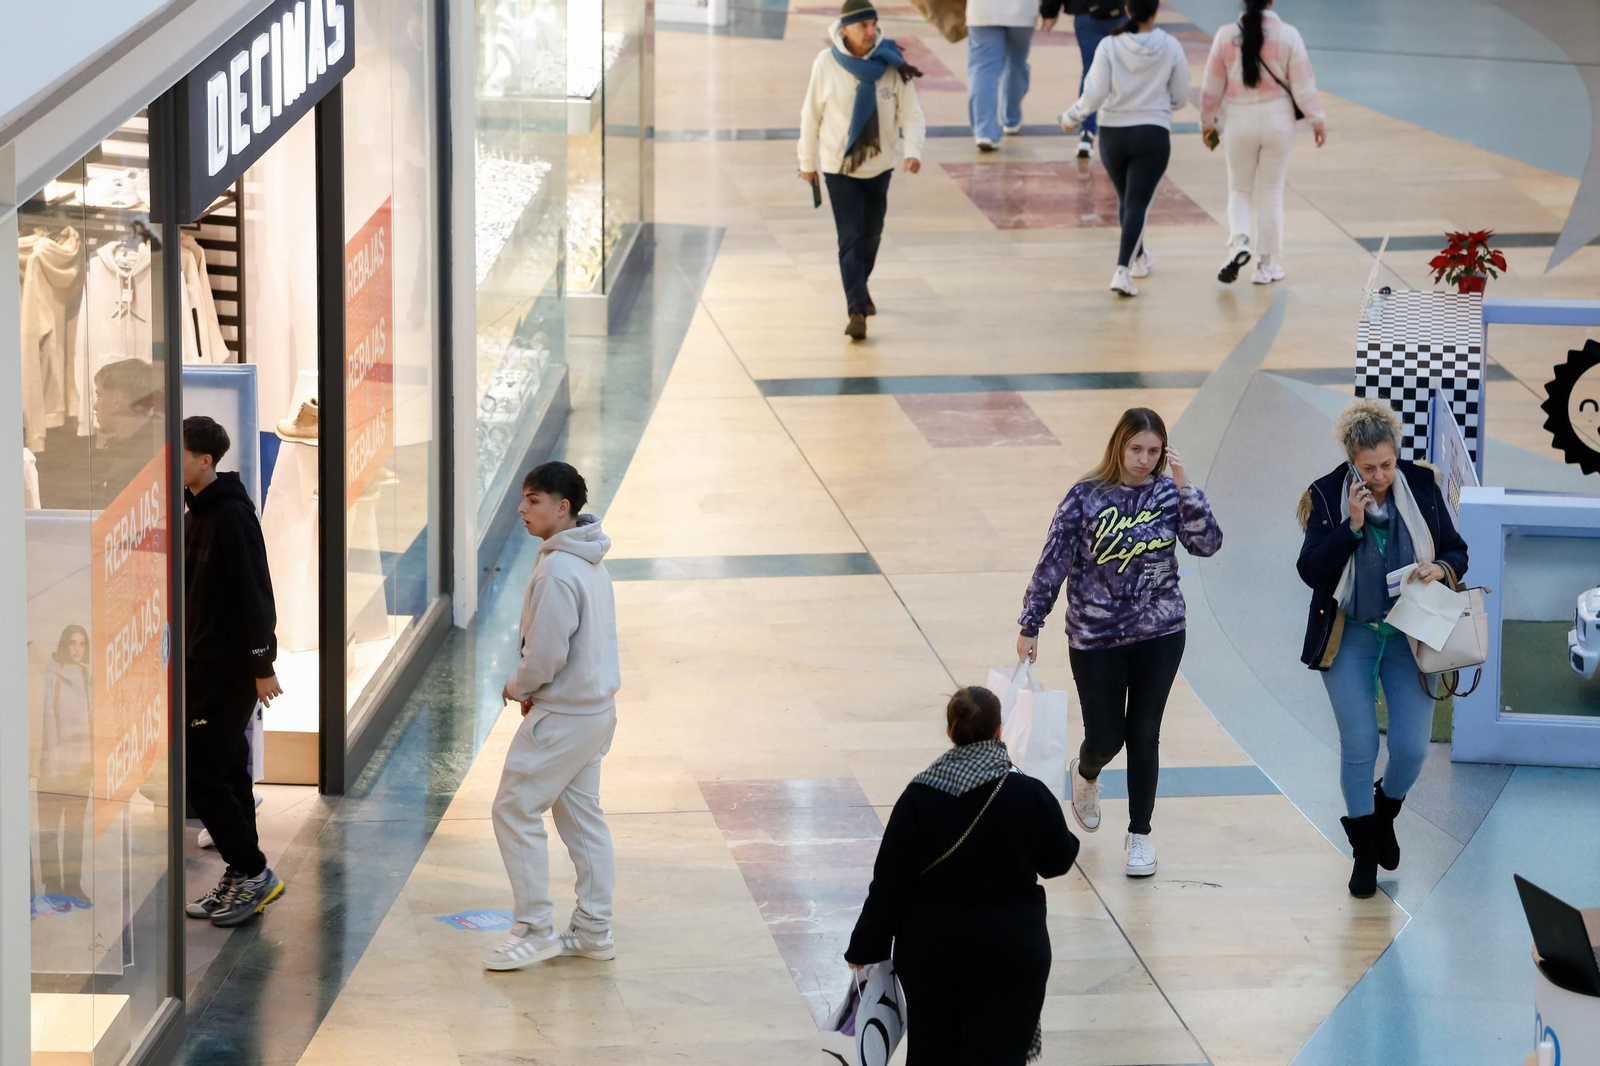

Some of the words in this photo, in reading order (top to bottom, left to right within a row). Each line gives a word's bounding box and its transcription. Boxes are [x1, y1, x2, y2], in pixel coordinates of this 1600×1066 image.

[207, 0, 345, 176] DECIMAS
[347, 226, 385, 302] REBAJAS
[348, 316, 386, 394] REBAJAS
[348, 406, 387, 486] REBAJAS
[104, 481, 160, 582] REBAJAS
[1092, 506, 1163, 554] Dua
[1096, 531, 1175, 573] Lipa
[105, 588, 161, 692] REBAJAS
[106, 694, 162, 802] REBAJAS
